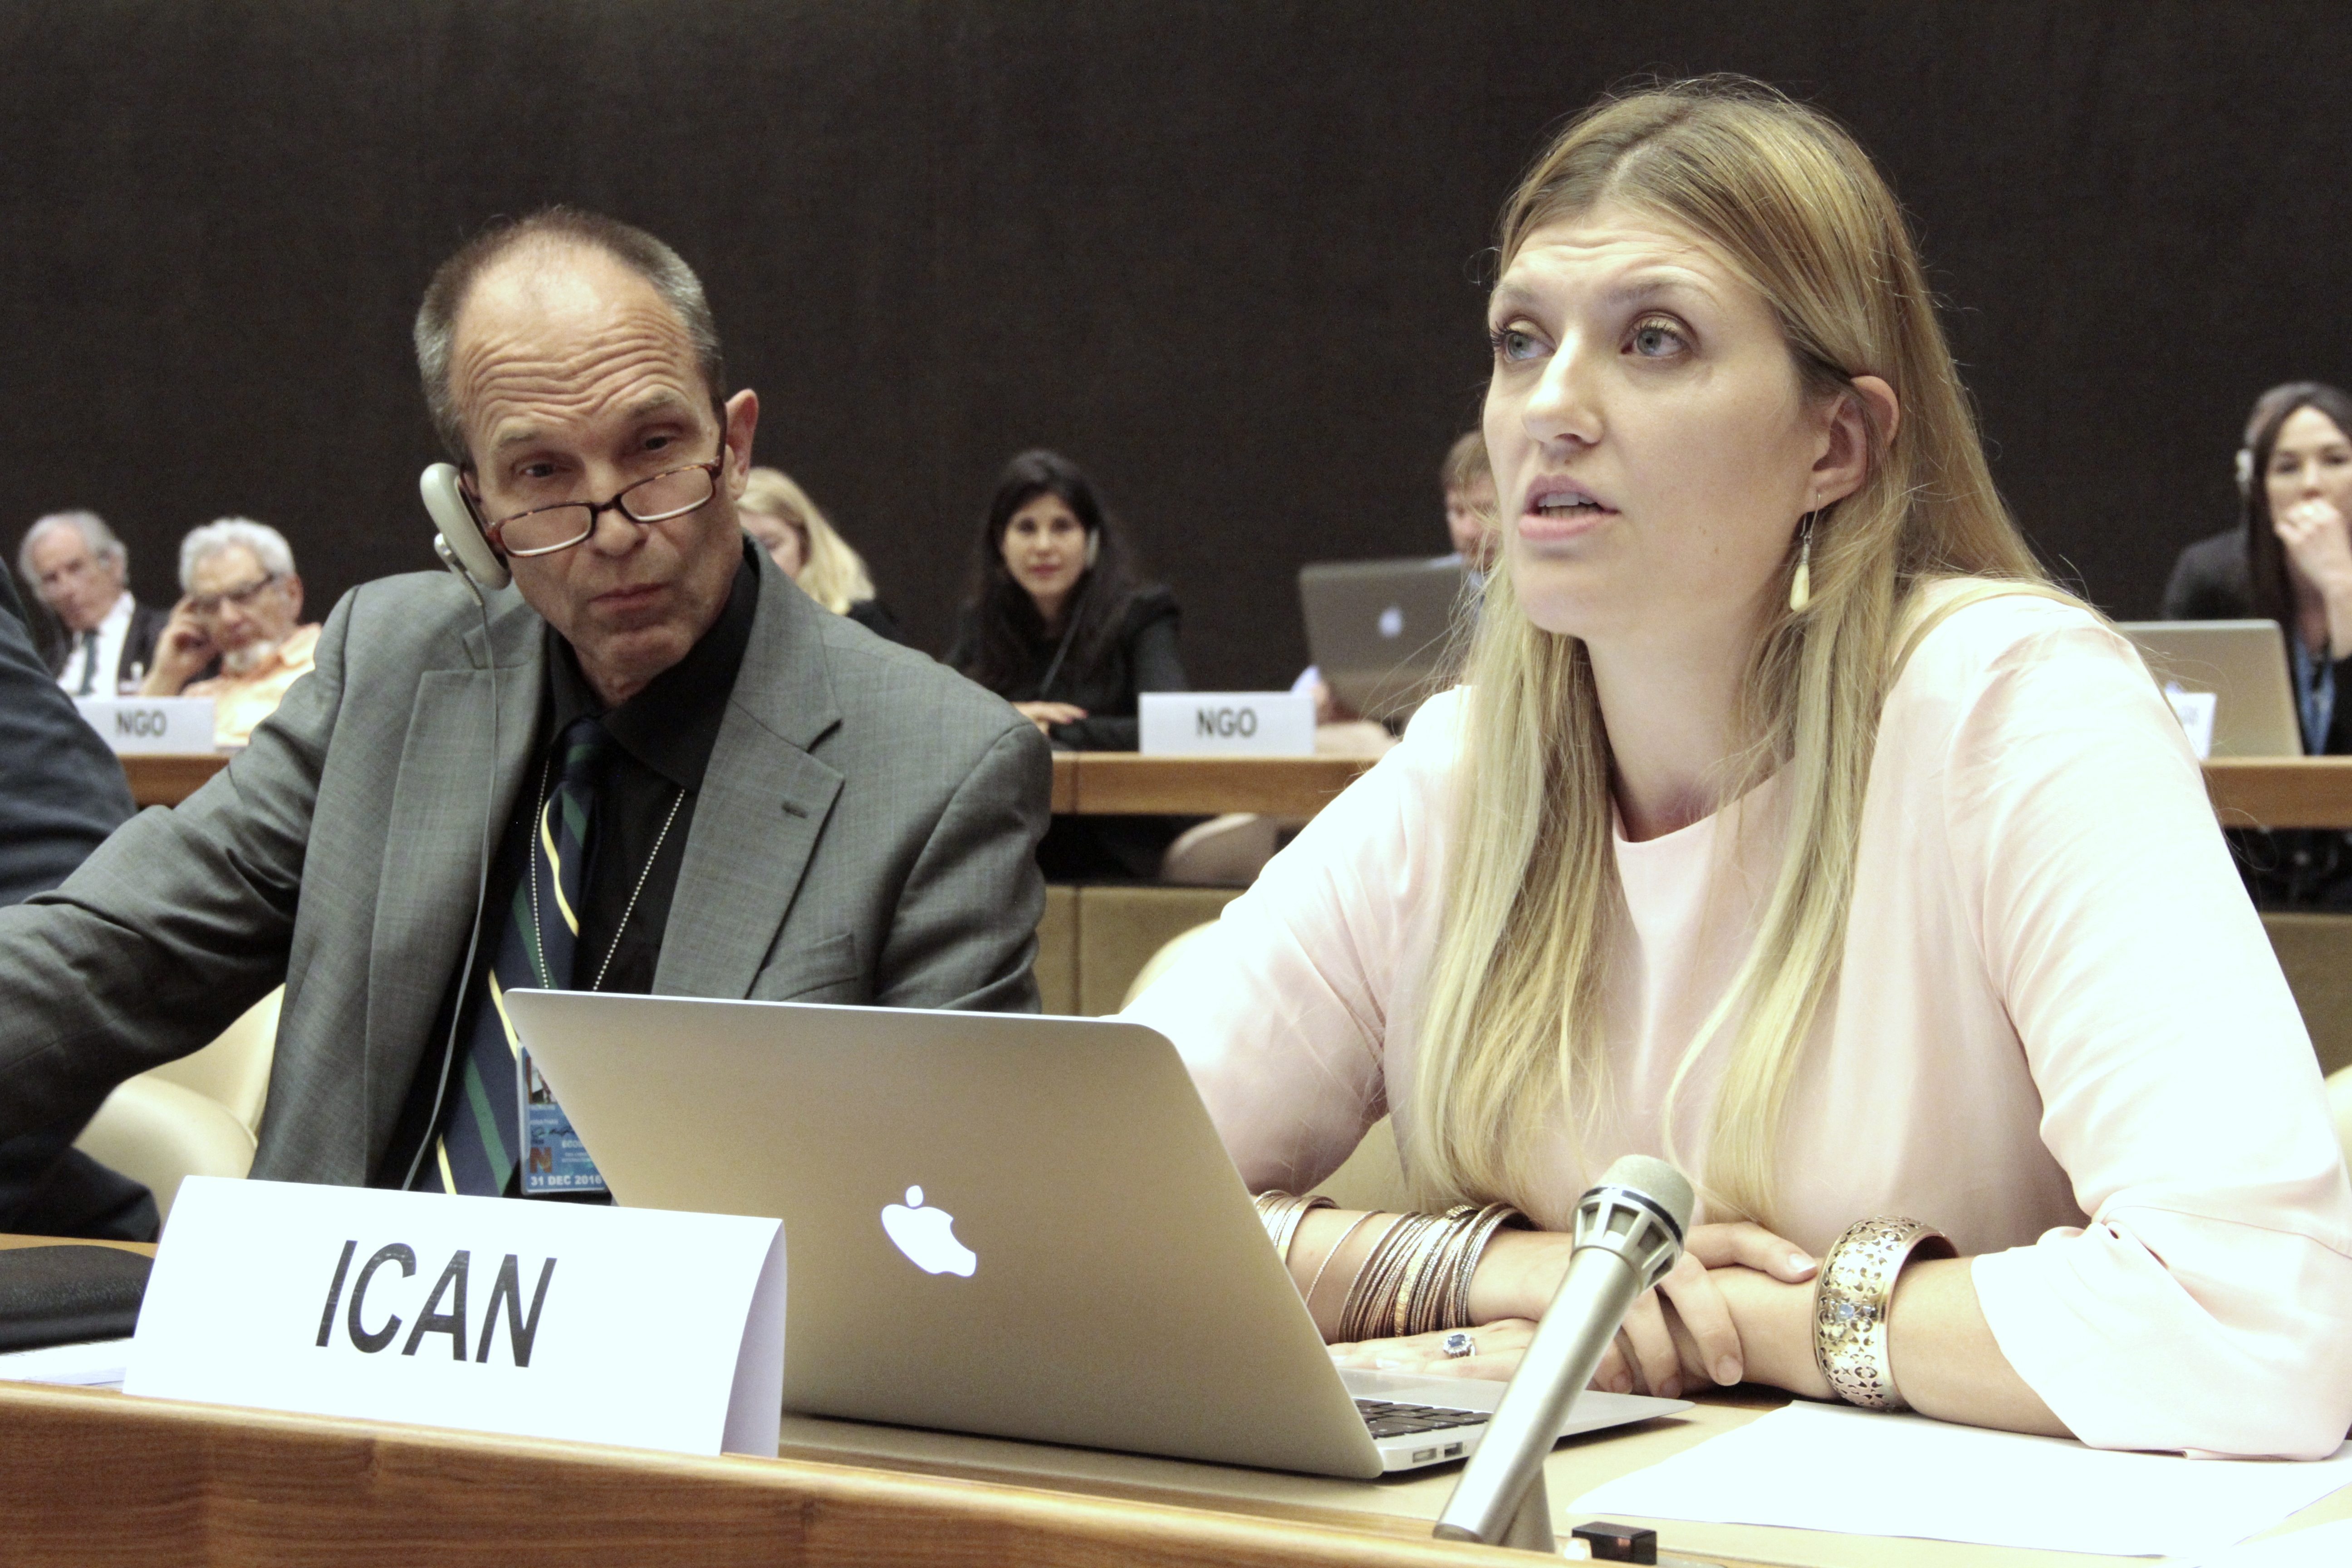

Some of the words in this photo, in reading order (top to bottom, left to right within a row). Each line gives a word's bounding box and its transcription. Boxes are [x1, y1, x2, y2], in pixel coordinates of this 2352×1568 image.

[115, 709, 167, 738] NGO
[1196, 708, 1257, 739] NGO
[530, 1147, 552, 1173] N
[531, 1176, 544, 1186] 31
[548, 1175, 571, 1186] DEC
[574, 1175, 602, 1185] 2016
[315, 1240, 558, 1368] ICAN
